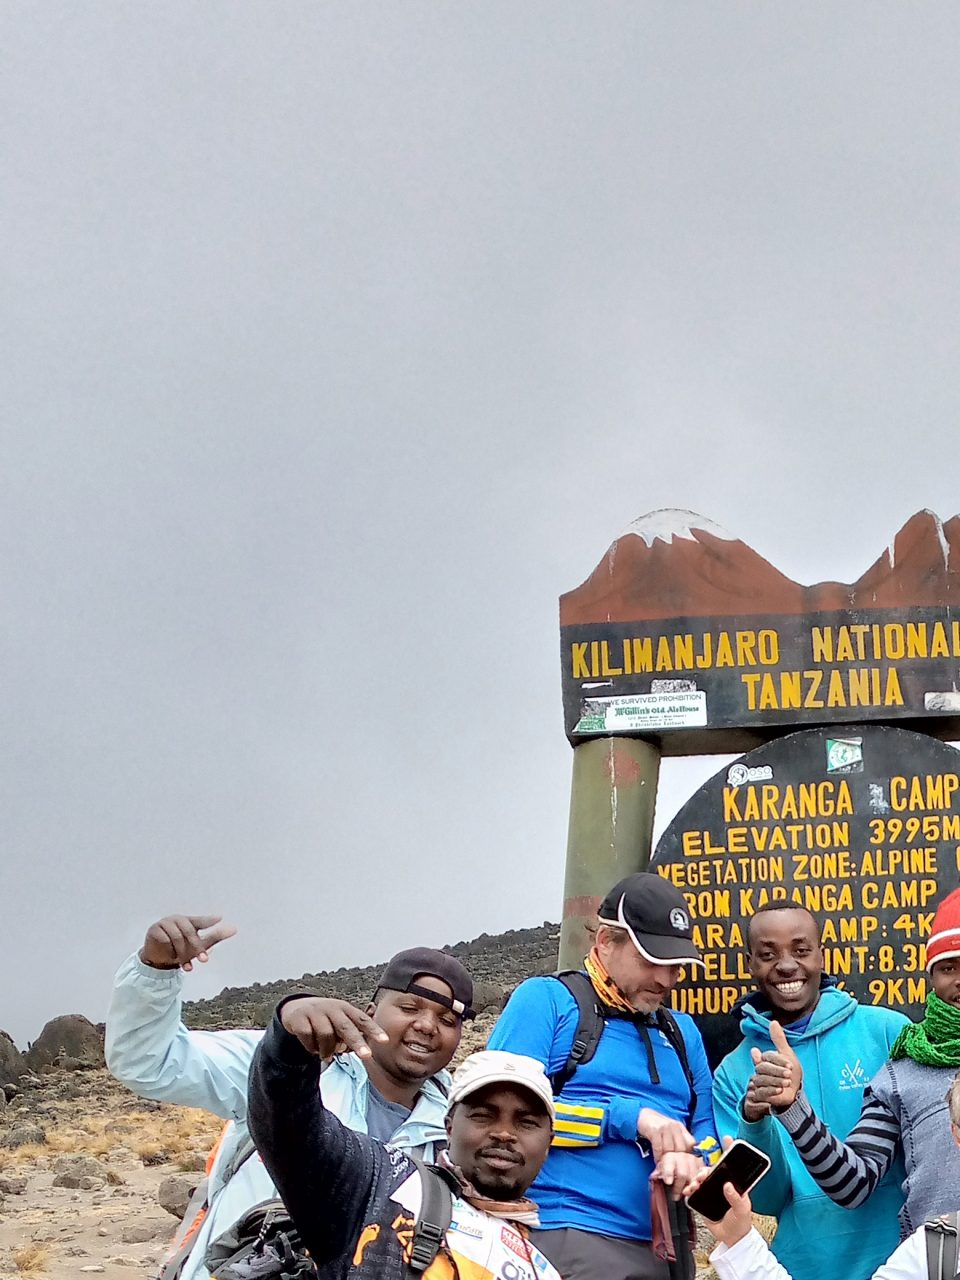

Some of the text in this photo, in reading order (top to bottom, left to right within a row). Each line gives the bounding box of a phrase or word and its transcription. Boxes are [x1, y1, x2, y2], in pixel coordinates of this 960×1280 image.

[572, 629, 780, 679] KILIMANJARO
[621, 696, 658, 705] SURVIVED
[658, 694, 702, 703] PROHIBITION
[741, 669, 904, 711] TANZANIA
[723, 773, 960, 822] KARANGA CAMP
[682, 822, 849, 857] ELEVATION
[869, 815, 960, 844] 3995M
[657, 857, 784, 888] VEGETATION
[684, 889, 731, 919] ROM
[739, 883, 854, 917] KARANGA
[861, 879, 937, 910] CAMP
[691, 922, 744, 950] ARA
[820, 914, 888, 944] AMP:
[893, 912, 935, 938] 4K
[671, 986, 757, 1016] UHUR
[868, 977, 927, 1006] 9KM
